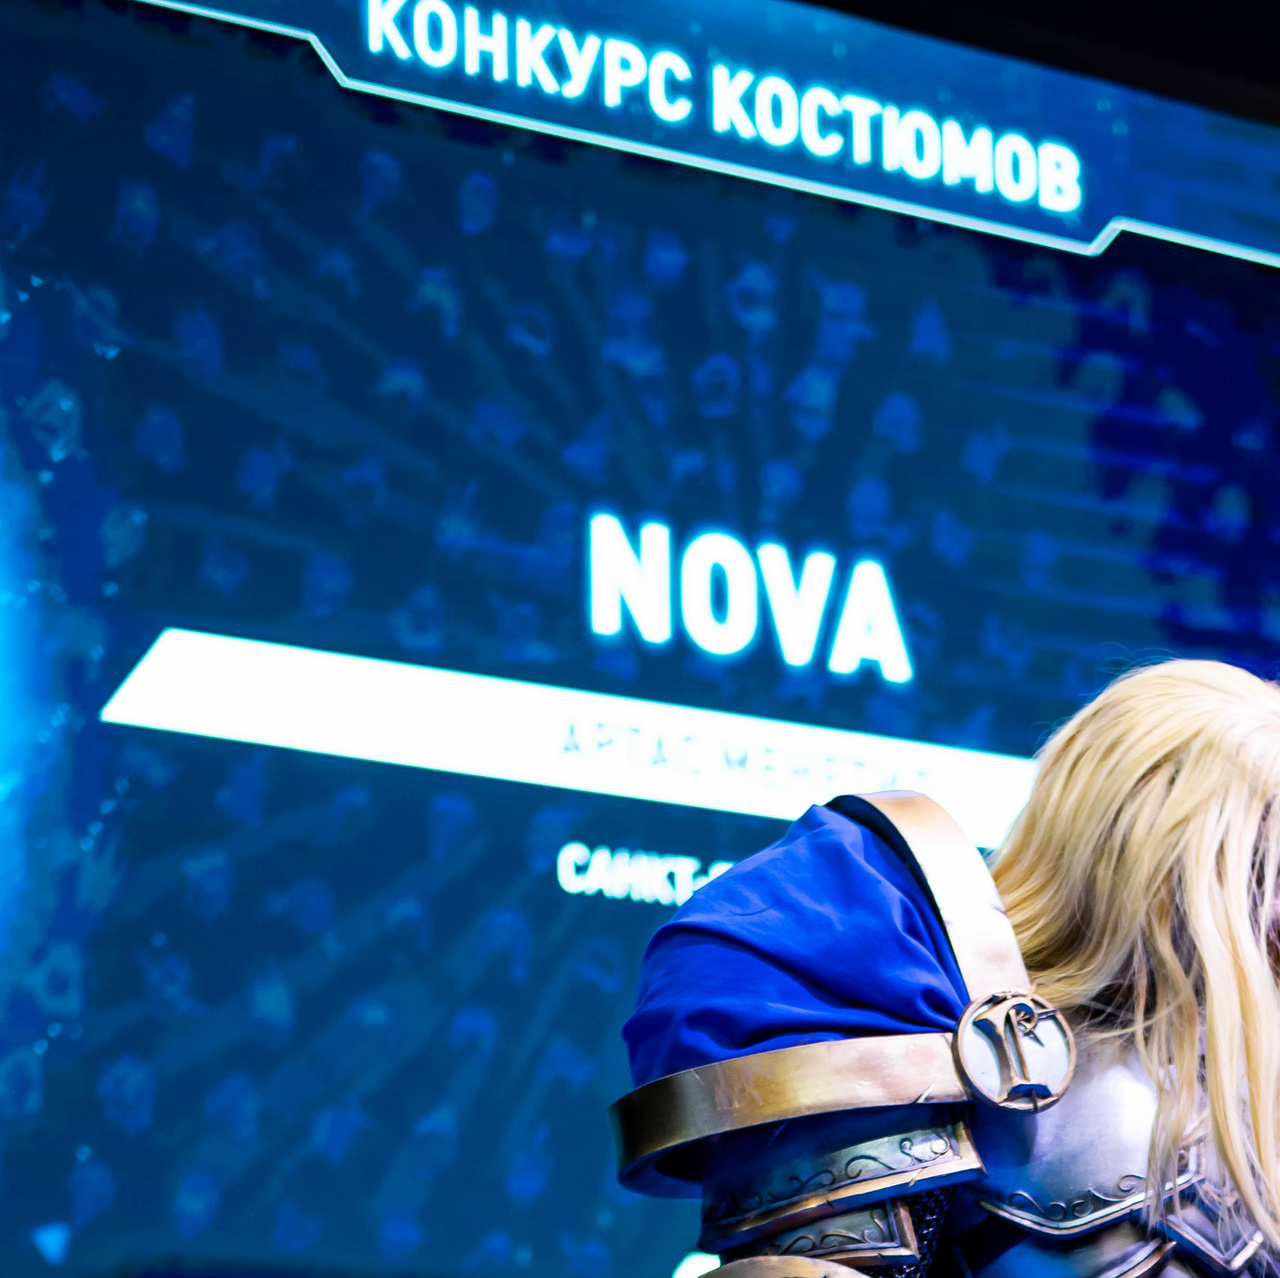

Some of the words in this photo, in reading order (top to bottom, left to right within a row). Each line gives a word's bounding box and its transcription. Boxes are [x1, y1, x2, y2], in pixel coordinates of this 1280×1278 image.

[366, 0, 694, 123] КОНКУРС
[711, 63, 1083, 213] КОСТЮМОВ
[588, 512, 914, 685] NOVA
[558, 716, 704, 780] АРТАС
[556, 840, 736, 907] САНКТ-
